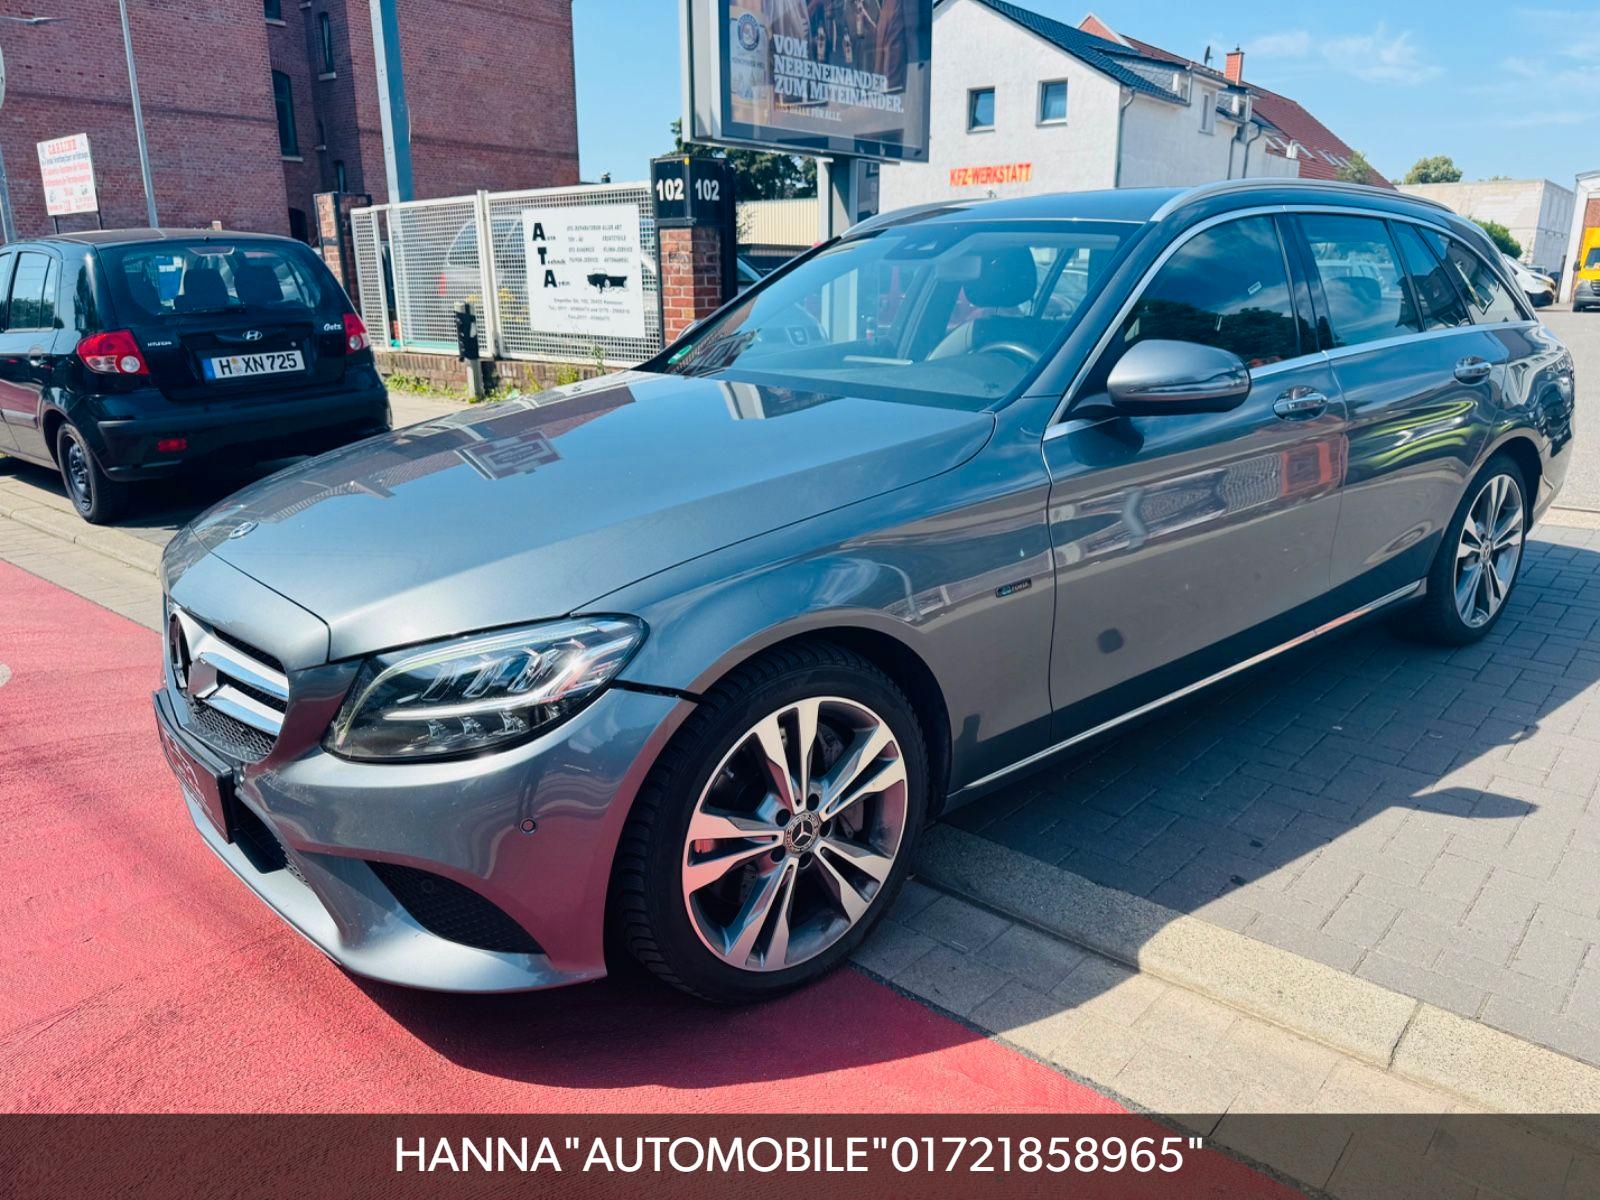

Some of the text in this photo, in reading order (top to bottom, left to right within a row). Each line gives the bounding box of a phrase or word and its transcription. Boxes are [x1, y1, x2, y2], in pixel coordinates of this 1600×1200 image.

[773, 34, 808, 58] VOM
[773, 55, 888, 92] NEBENEINANDER
[774, 74, 904, 113] ZUM MITEINANDER.
[949, 162, 1032, 187] KFZ-WERKSTATT
[656, 178, 684, 201] 102
[696, 178, 720, 201] 102
[323, 322, 343, 331] Getz
[220, 353, 297, 376] H XN 725
